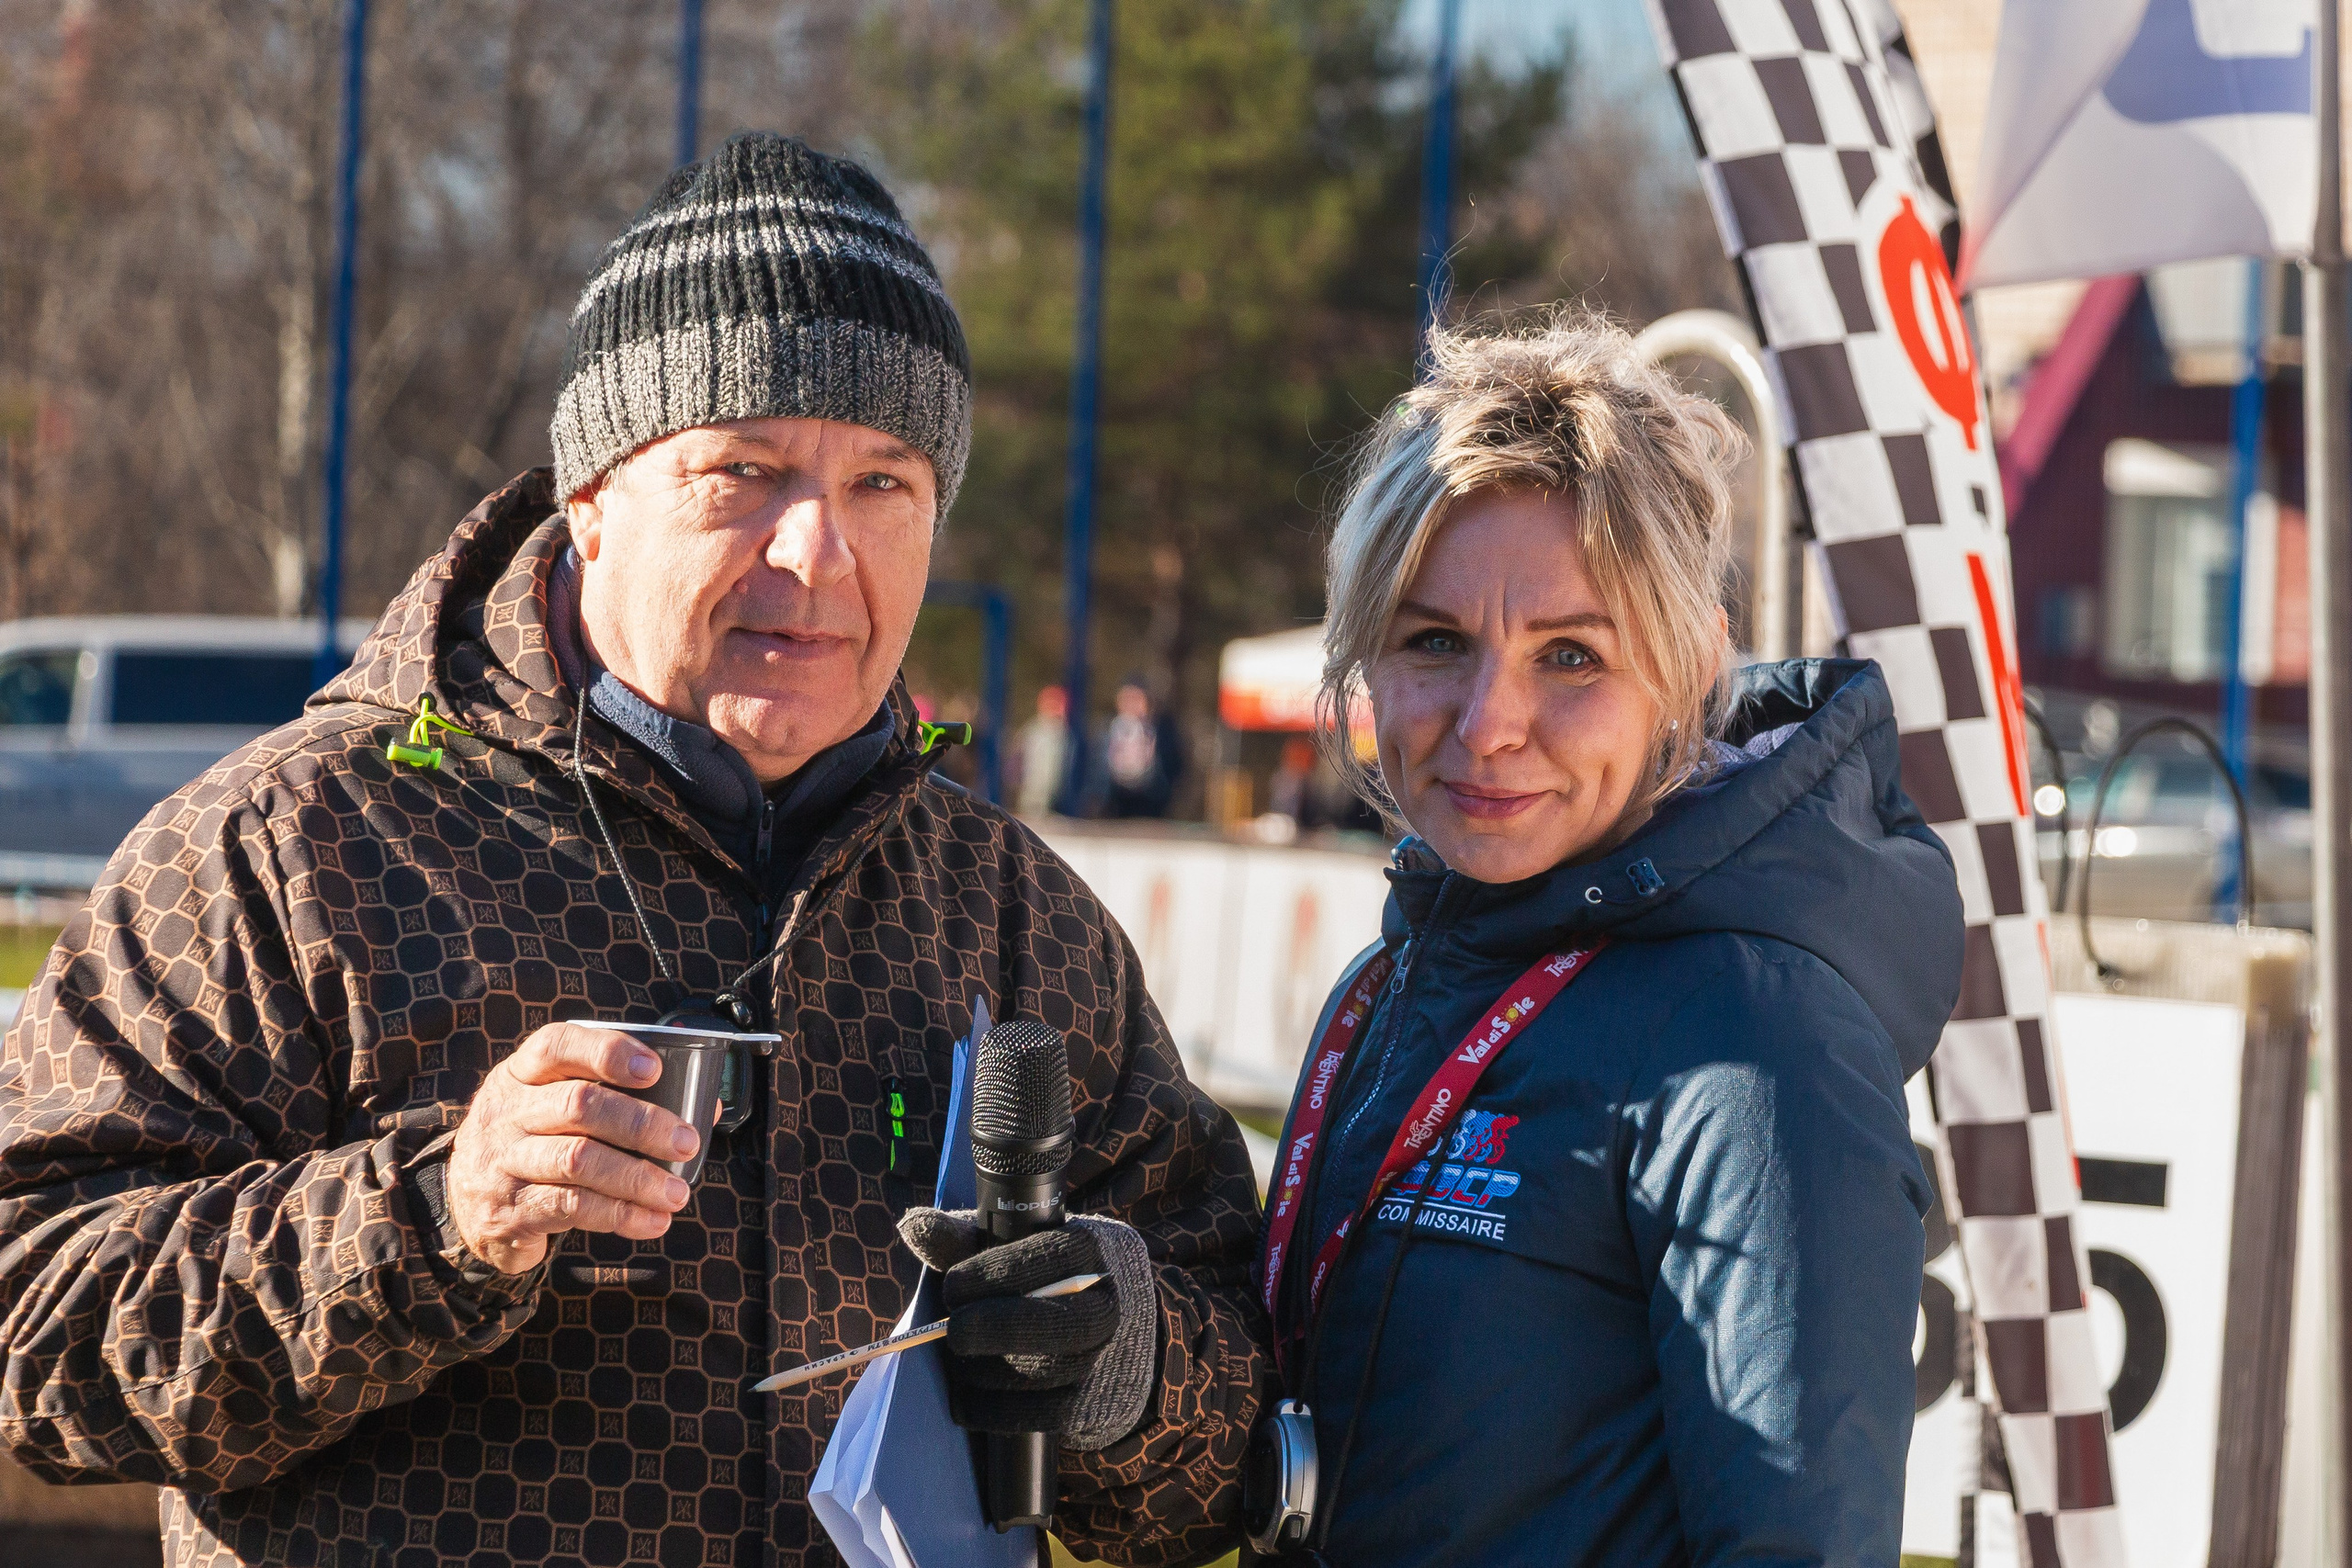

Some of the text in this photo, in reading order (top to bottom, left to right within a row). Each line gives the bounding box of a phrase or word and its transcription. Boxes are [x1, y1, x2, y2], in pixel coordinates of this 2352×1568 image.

[1457, 1038, 1492, 1064] Val
[1488, 1028, 1503, 1043] di
[1309, 1050, 1345, 1110] TRENTINO
[1403, 1088, 1452, 1148] TRENTINO
[1291, 1132, 1314, 1161] Val
[1288, 1162, 1298, 1176] di
[804, 1354, 845, 1371] КРАСИН
